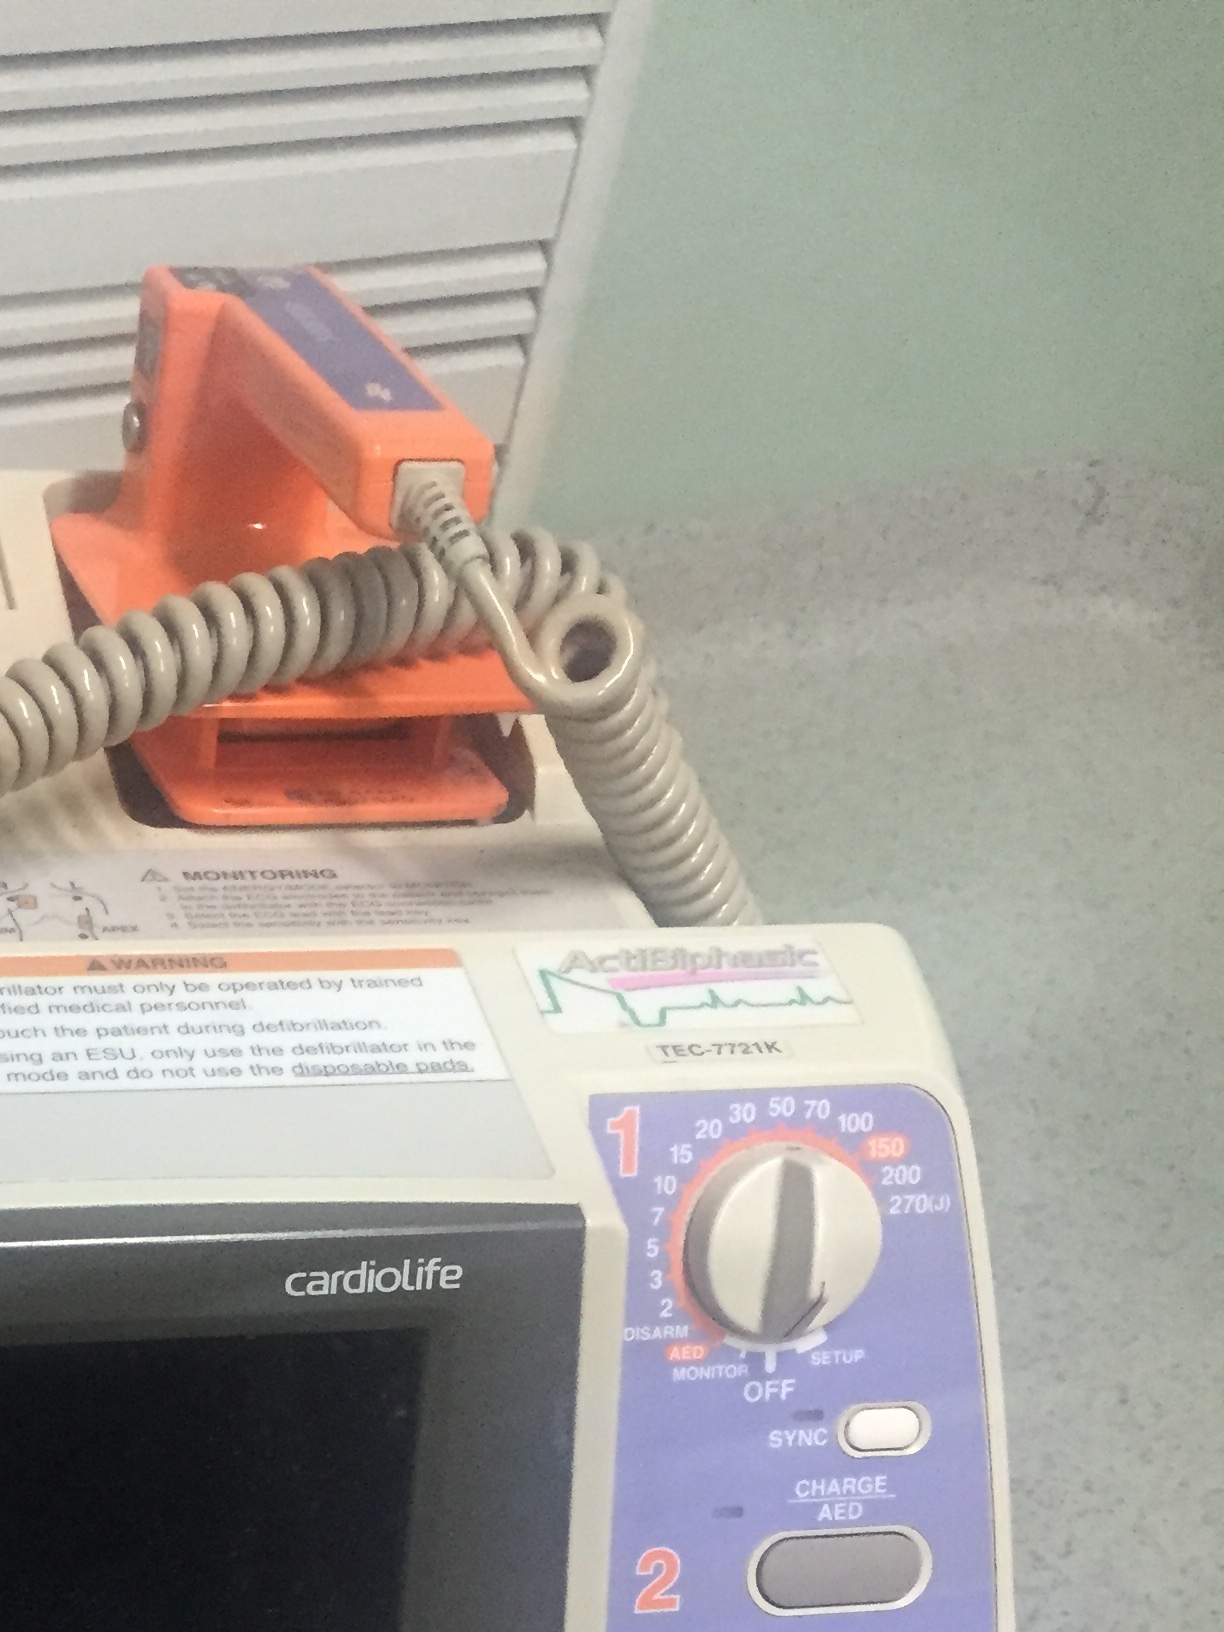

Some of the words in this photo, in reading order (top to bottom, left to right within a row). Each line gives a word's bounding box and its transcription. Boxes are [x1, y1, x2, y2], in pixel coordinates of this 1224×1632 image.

[182, 868, 338, 881] MONITORING
[110, 956, 227, 971] WARNING
[73, 982, 126, 996] must
[132, 981, 176, 998] only
[183, 980, 211, 993] be
[218, 978, 313, 994] operated
[318, 977, 343, 993] by
[350, 975, 424, 989] trained
[48, 1000, 133, 1015] medical
[54, 1024, 88, 1038] the
[96, 1022, 171, 1040] patient
[177, 1021, 246, 1036] during
[51, 1049, 78, 1062] an
[151, 1045, 196, 1062] only
[204, 1046, 243, 1058] use
[250, 1044, 284, 1057] the
[291, 1041, 410, 1055] defibrillator
[417, 1039, 435, 1052] in
[442, 1038, 476, 1051] the
[656, 1041, 783, 1058] TEC-7721K
[7, 1069, 69, 1083] mode
[78, 1068, 119, 1081] and
[126, 1066, 154, 1080] do
[161, 1065, 196, 1079] not
[204, 1066, 243, 1078] use
[250, 1064, 284, 1077] the
[291, 1060, 409, 1077] disposable
[729, 1102, 757, 1124] 30
[768, 1097, 796, 1118] 50
[804, 1099, 831, 1119] 70
[695, 1118, 723, 1140] 20
[838, 1112, 874, 1133] 100
[606, 1105, 640, 1178] 1
[867, 1137, 906, 1158] 150
[670, 1144, 693, 1164] 15
[655, 1175, 676, 1195] 10
[881, 1165, 921, 1185] 200
[651, 1208, 665, 1226] 7
[646, 1238, 660, 1258] 5
[284, 1257, 463, 1297] cardiolife
[649, 1270, 662, 1290] 3
[659, 1299, 673, 1318] 2
[624, 1325, 689, 1342] DISARM
[669, 1345, 705, 1360] AED
[811, 1348, 866, 1365] SETUP
[672, 1363, 749, 1381] MONITOR
[743, 1378, 796, 1402] OFF
[769, 1427, 829, 1448] SYNC
[794, 1476, 888, 1498] CHARGE
[817, 1502, 863, 1521] AED
[634, 1547, 681, 1614] 2
